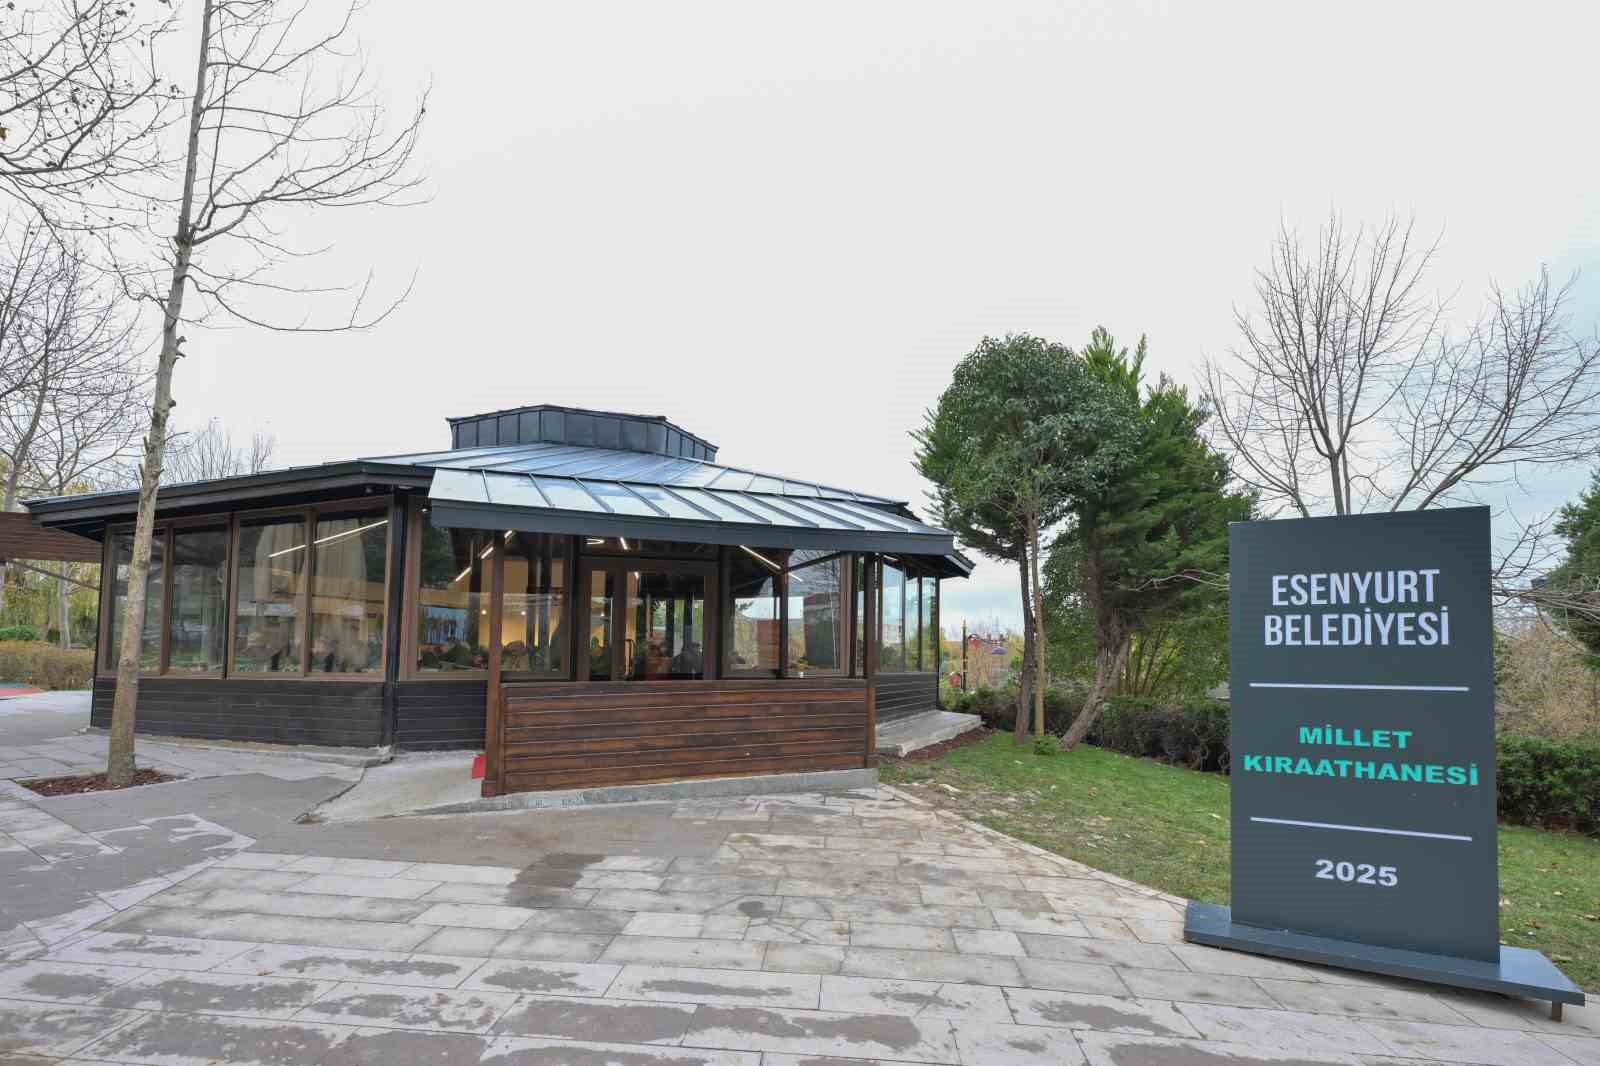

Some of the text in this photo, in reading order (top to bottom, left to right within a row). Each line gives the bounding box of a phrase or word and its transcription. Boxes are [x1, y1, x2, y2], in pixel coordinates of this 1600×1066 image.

[1272, 569, 1440, 605] ESENYURT
[1265, 606, 1448, 645] BELEDİYESİ
[1300, 724, 1412, 748] MİLLET
[1244, 755, 1478, 785] KIRAATHANESİ
[1315, 859, 1398, 886] 2025
